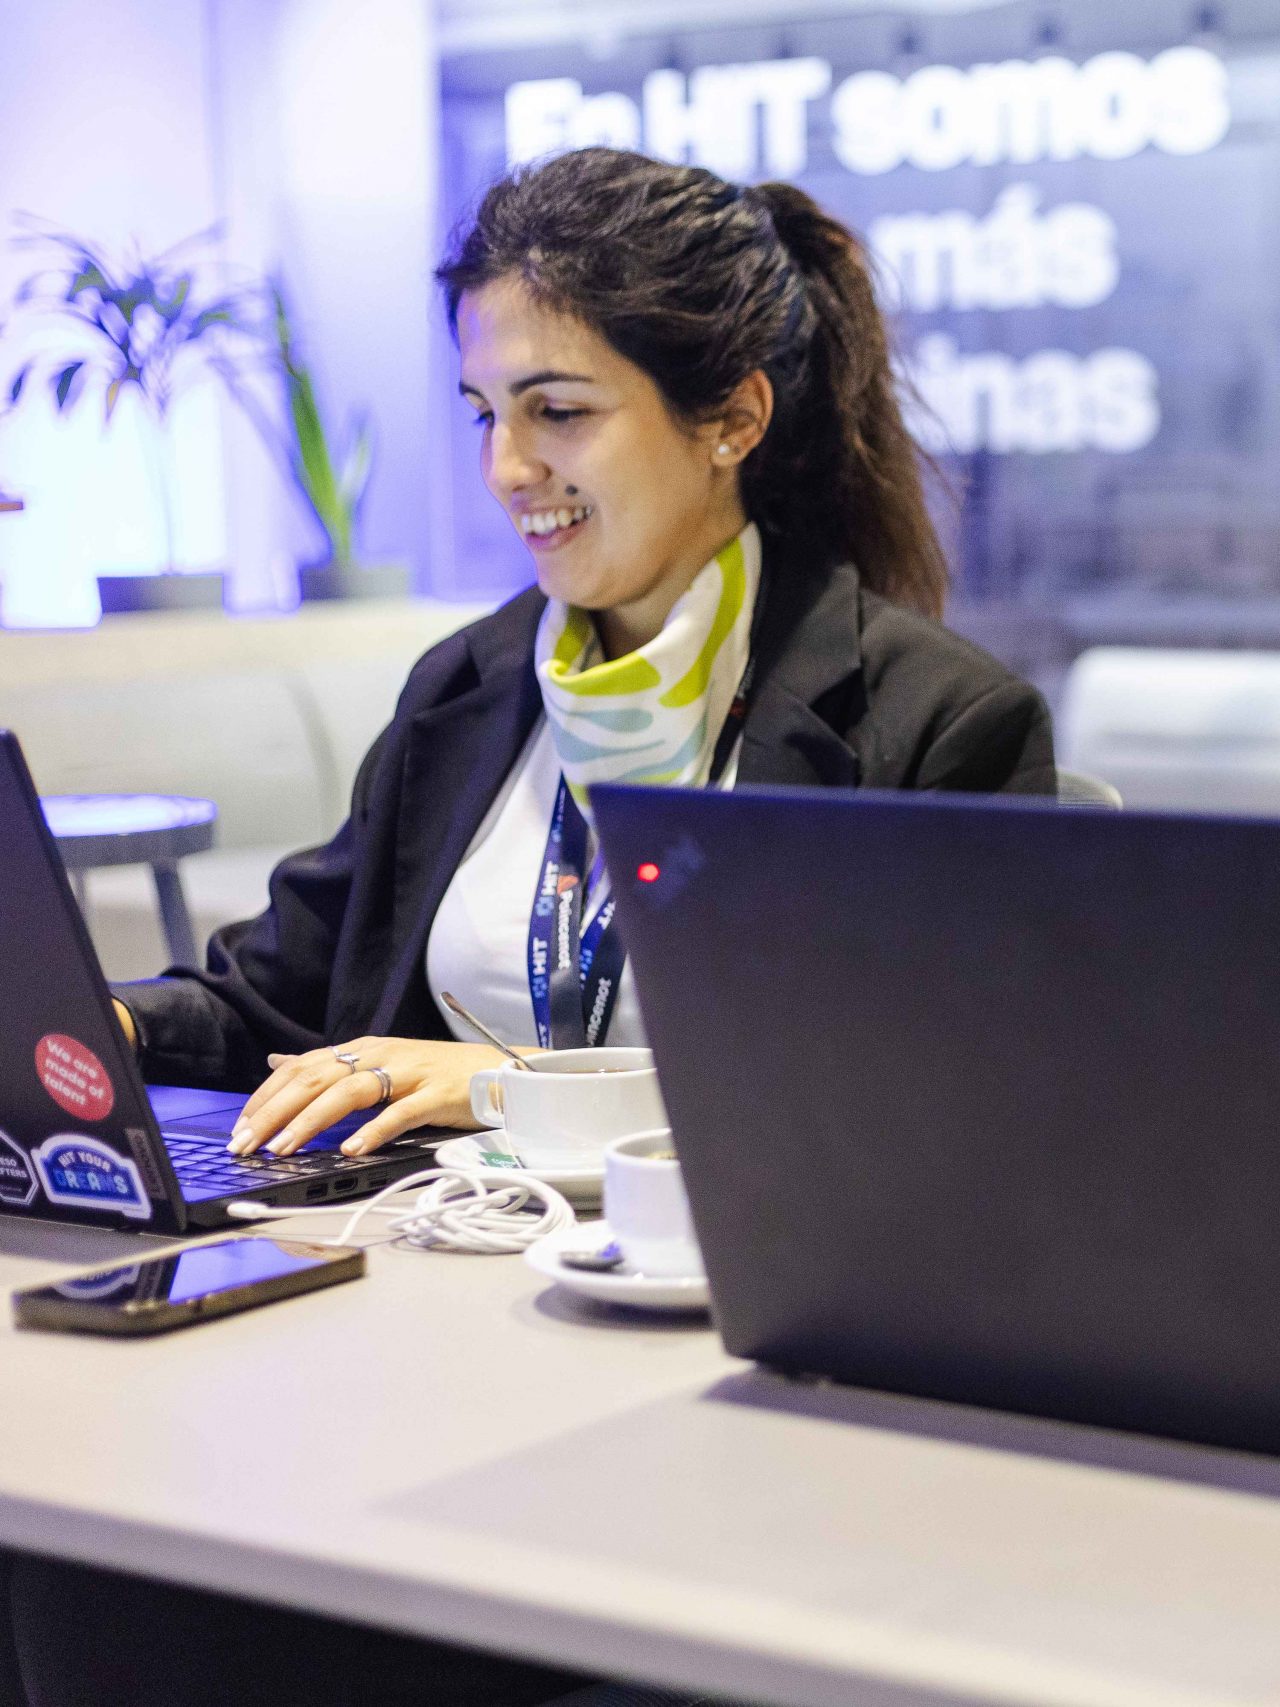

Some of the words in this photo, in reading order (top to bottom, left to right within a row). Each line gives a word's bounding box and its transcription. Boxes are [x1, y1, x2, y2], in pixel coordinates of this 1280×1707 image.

[642, 56, 832, 182] HIT
[831, 46, 1231, 176] somos
[866, 183, 1119, 314] más
[893, 332, 1161, 454] inas
[541, 861, 559, 896] HIT
[532, 937, 548, 976] HIT
[45, 1058, 87, 1089] made
[88, 1085, 105, 1099] of
[47, 1039, 71, 1063] We
[73, 1058, 98, 1080] are
[44, 1073, 87, 1106] talent
[77, 1151, 111, 1173] YOUR
